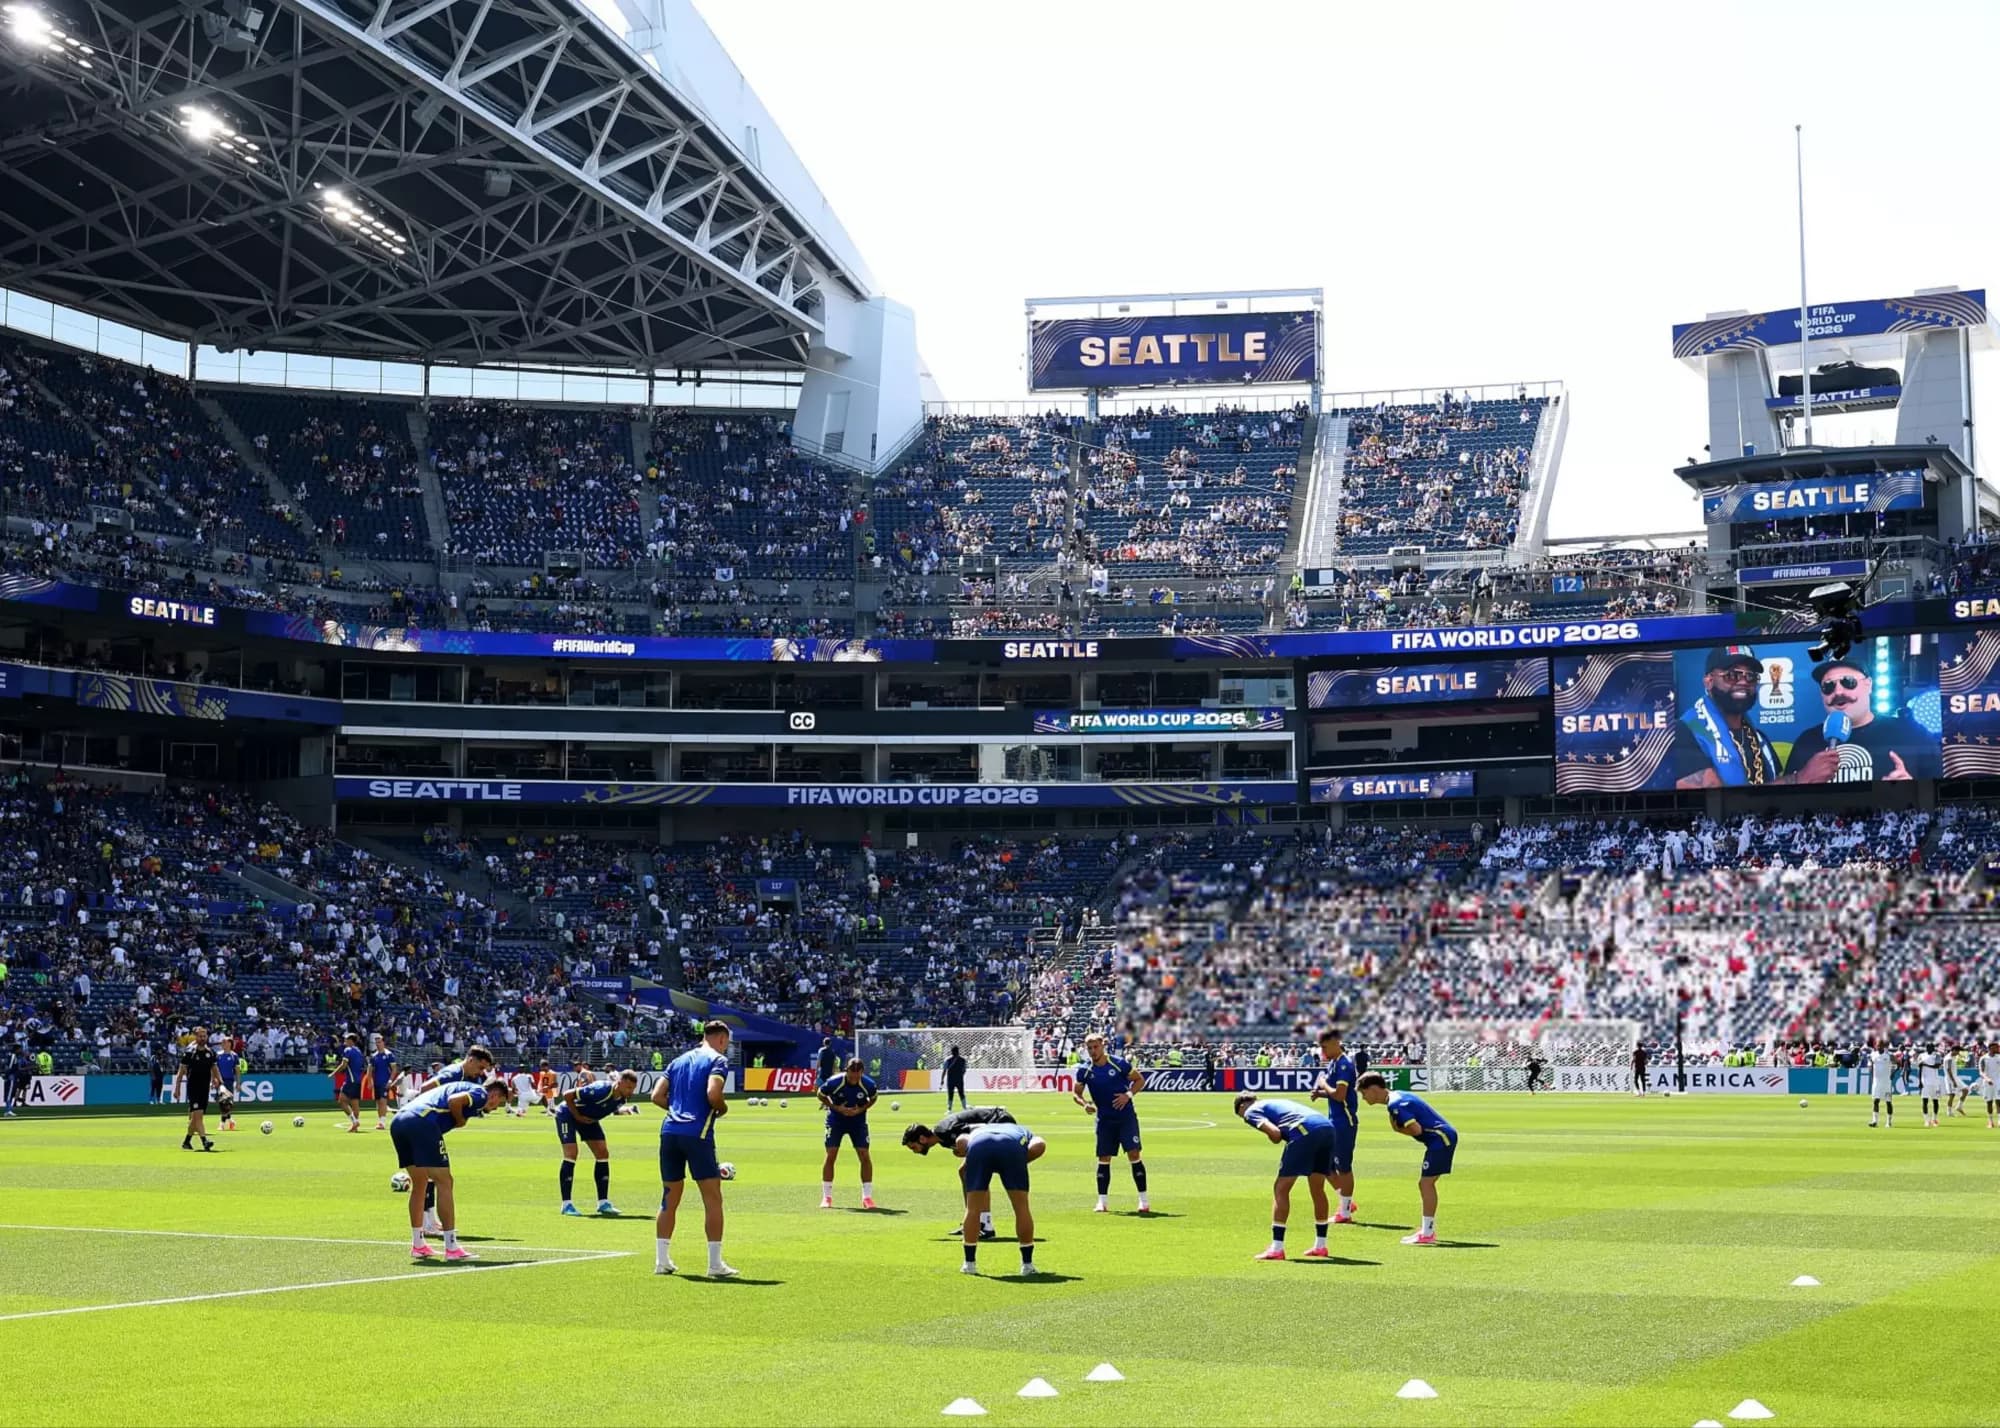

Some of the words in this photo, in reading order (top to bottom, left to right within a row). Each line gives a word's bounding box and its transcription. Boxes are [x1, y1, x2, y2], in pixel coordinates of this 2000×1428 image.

[1812, 306, 1835, 317] FIFA
[1834, 313, 1856, 324] CUP
[1806, 324, 1843, 336] 2026
[1080, 332, 1267, 367] SEATTLE
[1794, 387, 1871, 404] SEATTLE
[1753, 484, 1869, 511] SEATTLE
[1773, 565, 1831, 579] #FIFAWorldCup
[1558, 577, 1577, 592] 12
[131, 595, 215, 625] SEATTLE
[1391, 632, 1436, 650] FIFA
[1438, 628, 1518, 648] WORLD
[1520, 626, 1561, 645] CUP
[1562, 622, 1639, 642] 2026
[553, 639, 635, 657] #FIFAWorldCup
[1004, 641, 1098, 659] SEATTLE
[1375, 671, 1477, 695] SEATTLE
[1769, 697, 1784, 705] FIFA
[792, 715, 812, 728] CC
[1070, 715, 1102, 728] FIFA
[1104, 713, 1159, 728] WORLD
[1161, 713, 1191, 727] CUP
[1193, 711, 1246, 727] 2026
[1562, 711, 1667, 733] SEATTLE
[1759, 715, 1795, 724] 2026
[368, 780, 522, 800] SEATTLE
[1353, 777, 1430, 796] SEATTLE
[788, 788, 833, 806] FIFA
[835, 788, 915, 806] WORLD
[917, 788, 961, 806] CUP
[963, 788, 1039, 806] 2026
[160, 1074, 275, 1103] Hise
[772, 1068, 813, 1092] Lay's
[982, 1073, 1073, 1092] verzon
[1657, 1073, 1756, 1088] AMERICA
